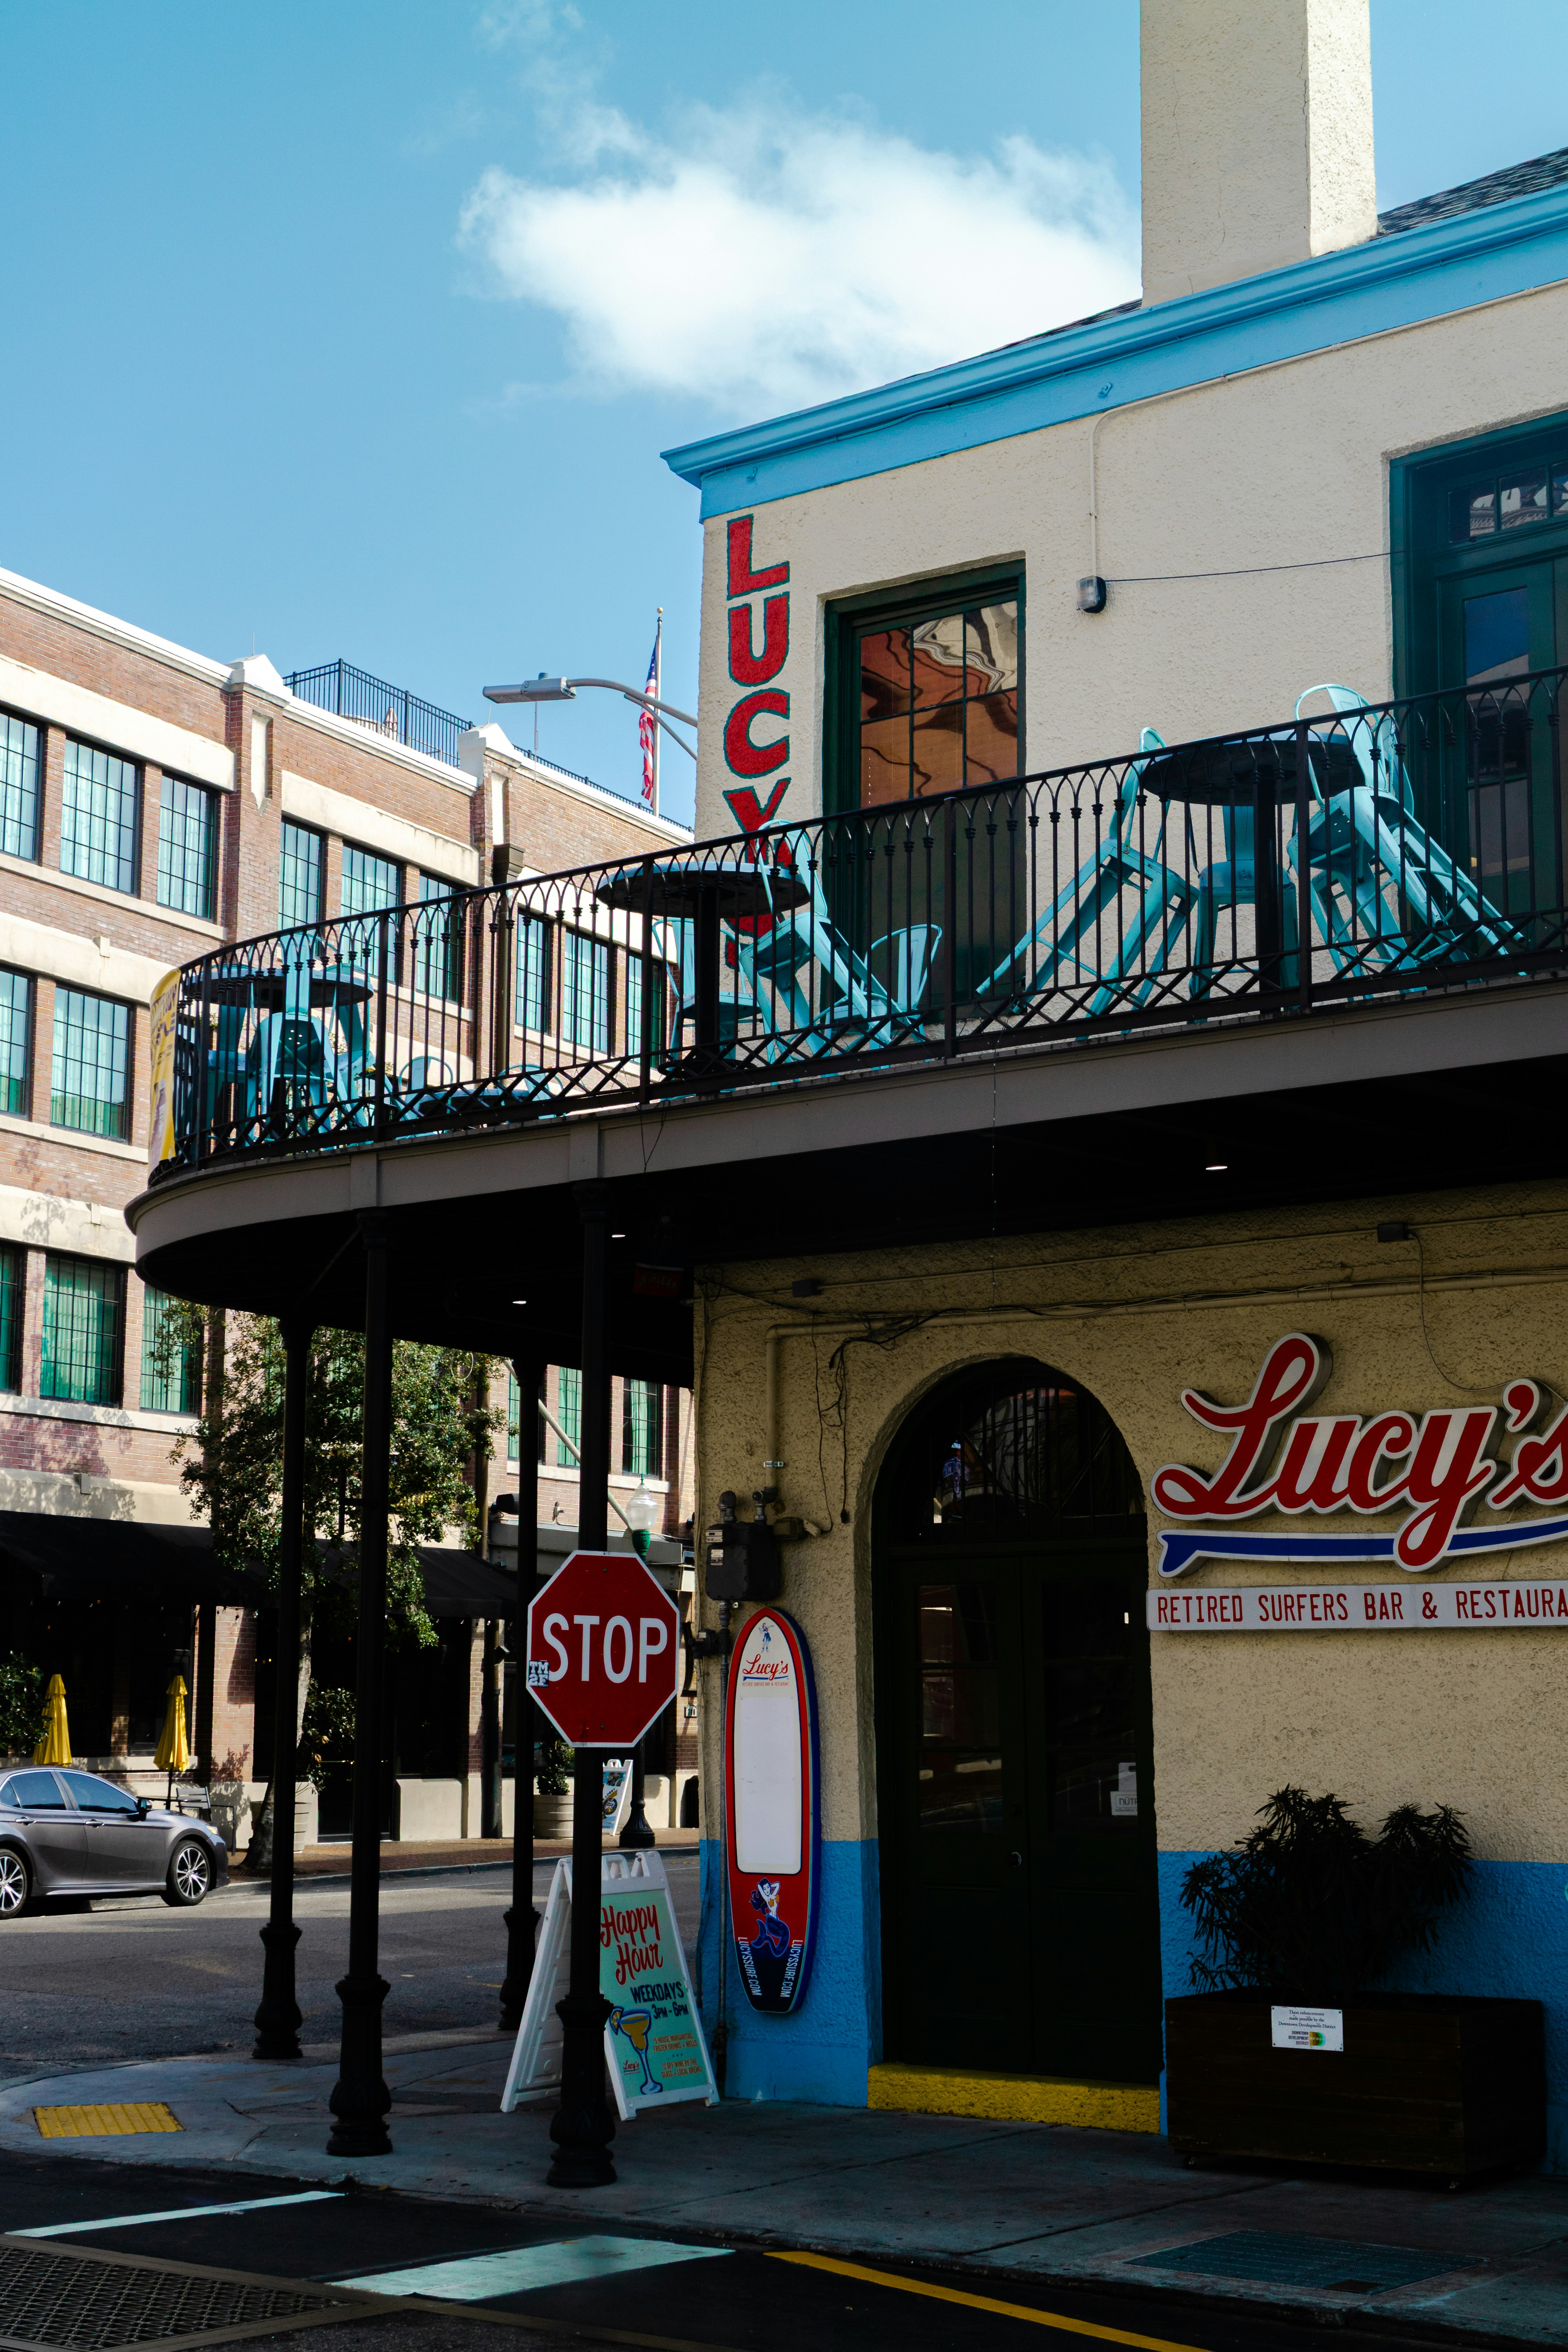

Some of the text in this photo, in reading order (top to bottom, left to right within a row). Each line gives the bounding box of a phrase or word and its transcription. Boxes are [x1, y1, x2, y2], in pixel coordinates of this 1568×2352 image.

[1150, 1332, 1568, 1573] Lucy's
[1157, 1595, 1244, 1623] RETIRED
[1258, 1593, 1348, 1621] SURFERS
[1365, 1592, 1403, 1619] BAR
[1422, 1592, 1438, 1619] &
[543, 1613, 668, 1684] STOP
[529, 1674, 548, 1686] 2F
[530, 1661, 549, 1674] TM
[742, 1654, 788, 1681] Lucy's
[600, 1904, 661, 1948] Happy
[616, 1944, 664, 1985] Hour
[737, 1936, 763, 1996] LUCYSSURF.COM
[780, 1939, 803, 1998] LUCYSSURF.COM
[630, 1981, 685, 2004] WEEKDAYS
[652, 2004, 668, 2020] 3PM
[672, 2001, 689, 2017] 6PM
[658, 2036, 670, 2044] HOUSE
[668, 2042, 681, 2050] DRINKS
[623, 2059, 640, 2071] Lucy's
